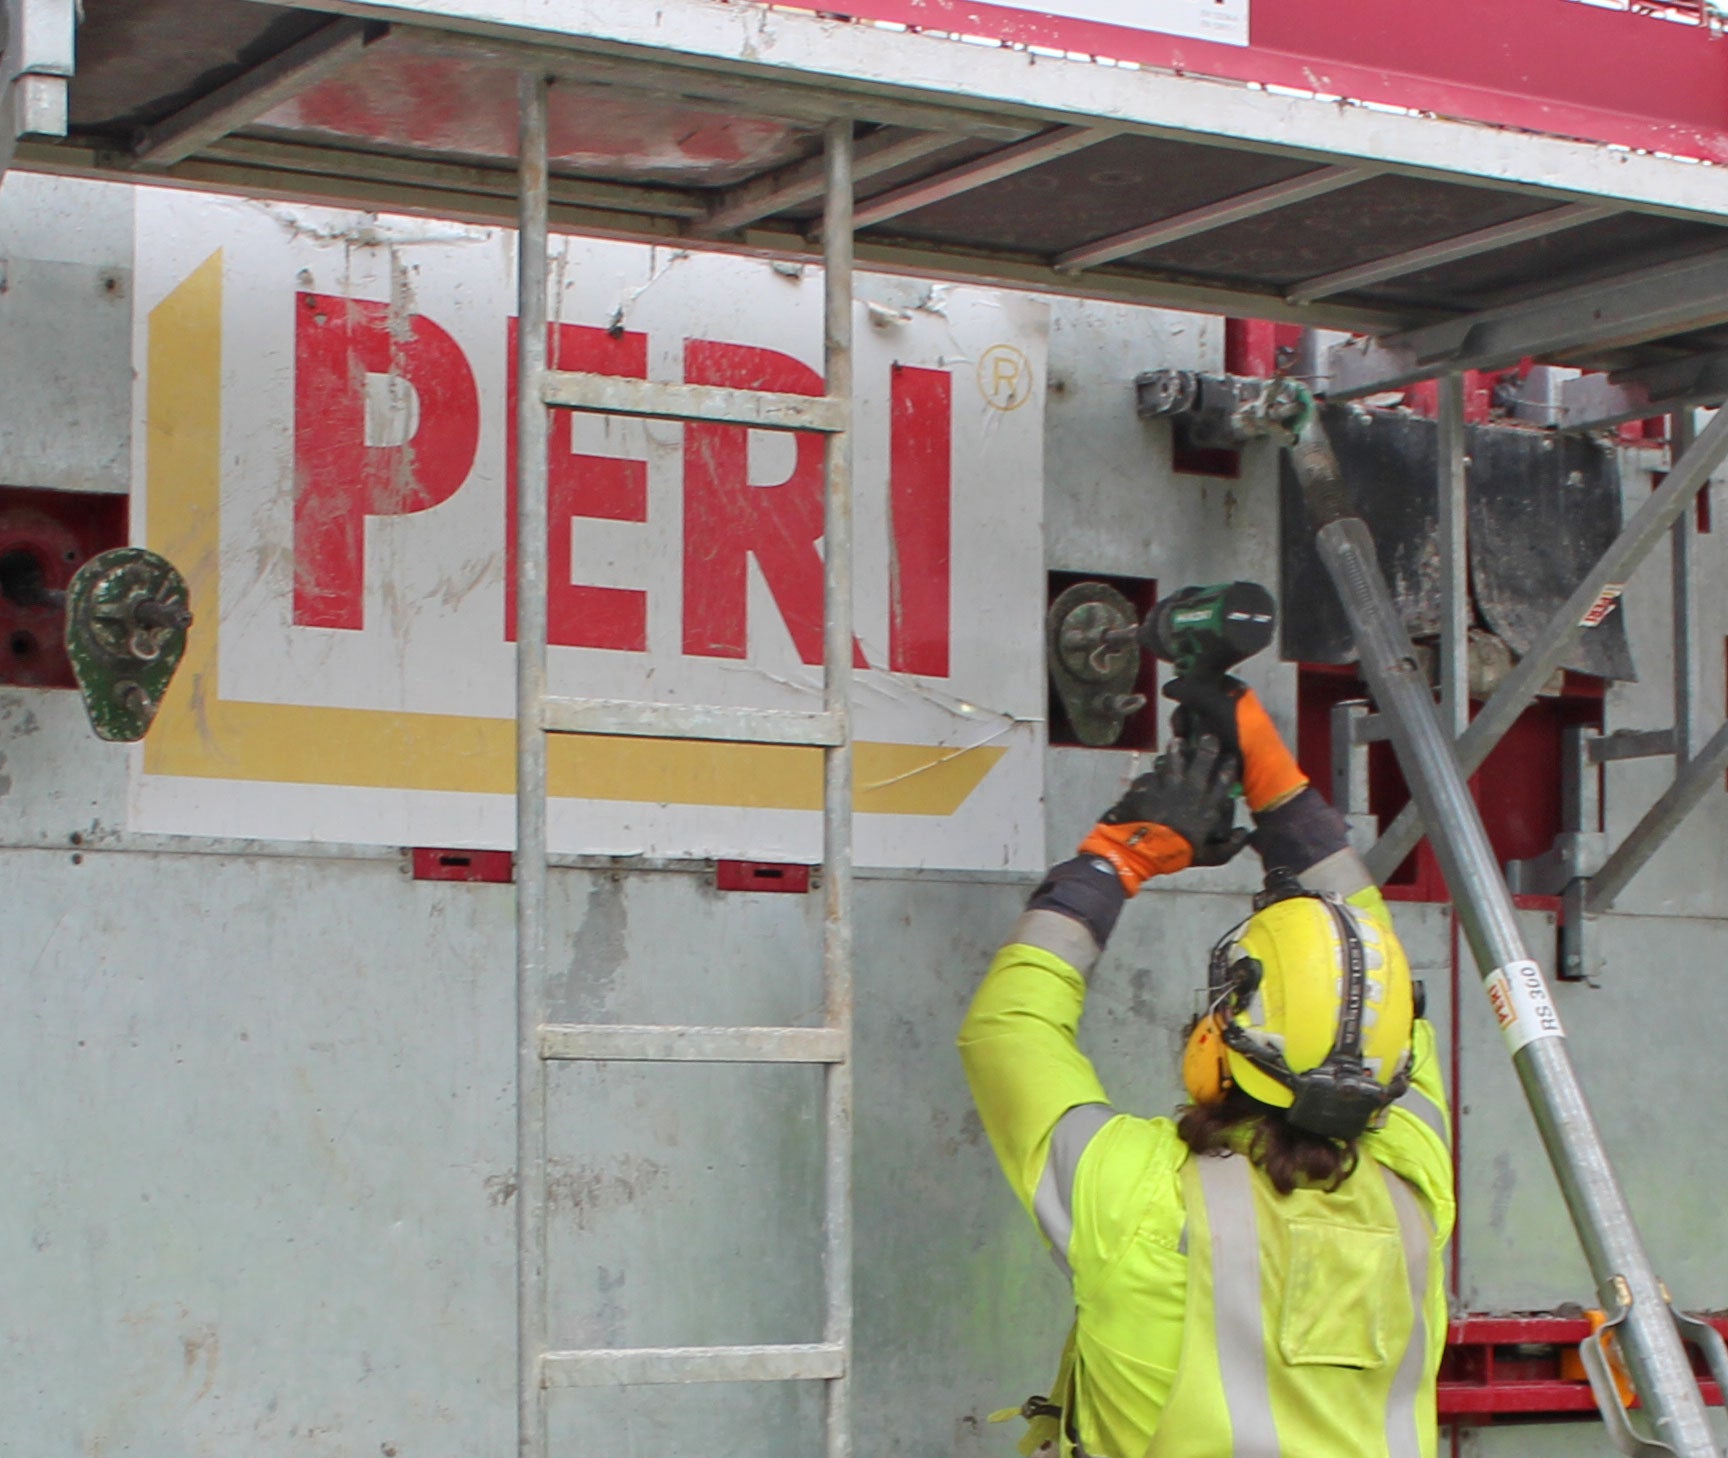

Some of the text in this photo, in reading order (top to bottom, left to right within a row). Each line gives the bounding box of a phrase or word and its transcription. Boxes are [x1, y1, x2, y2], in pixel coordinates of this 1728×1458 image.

[293, 291, 951, 678] PERI
[1520, 966, 1559, 1031] RS 300
